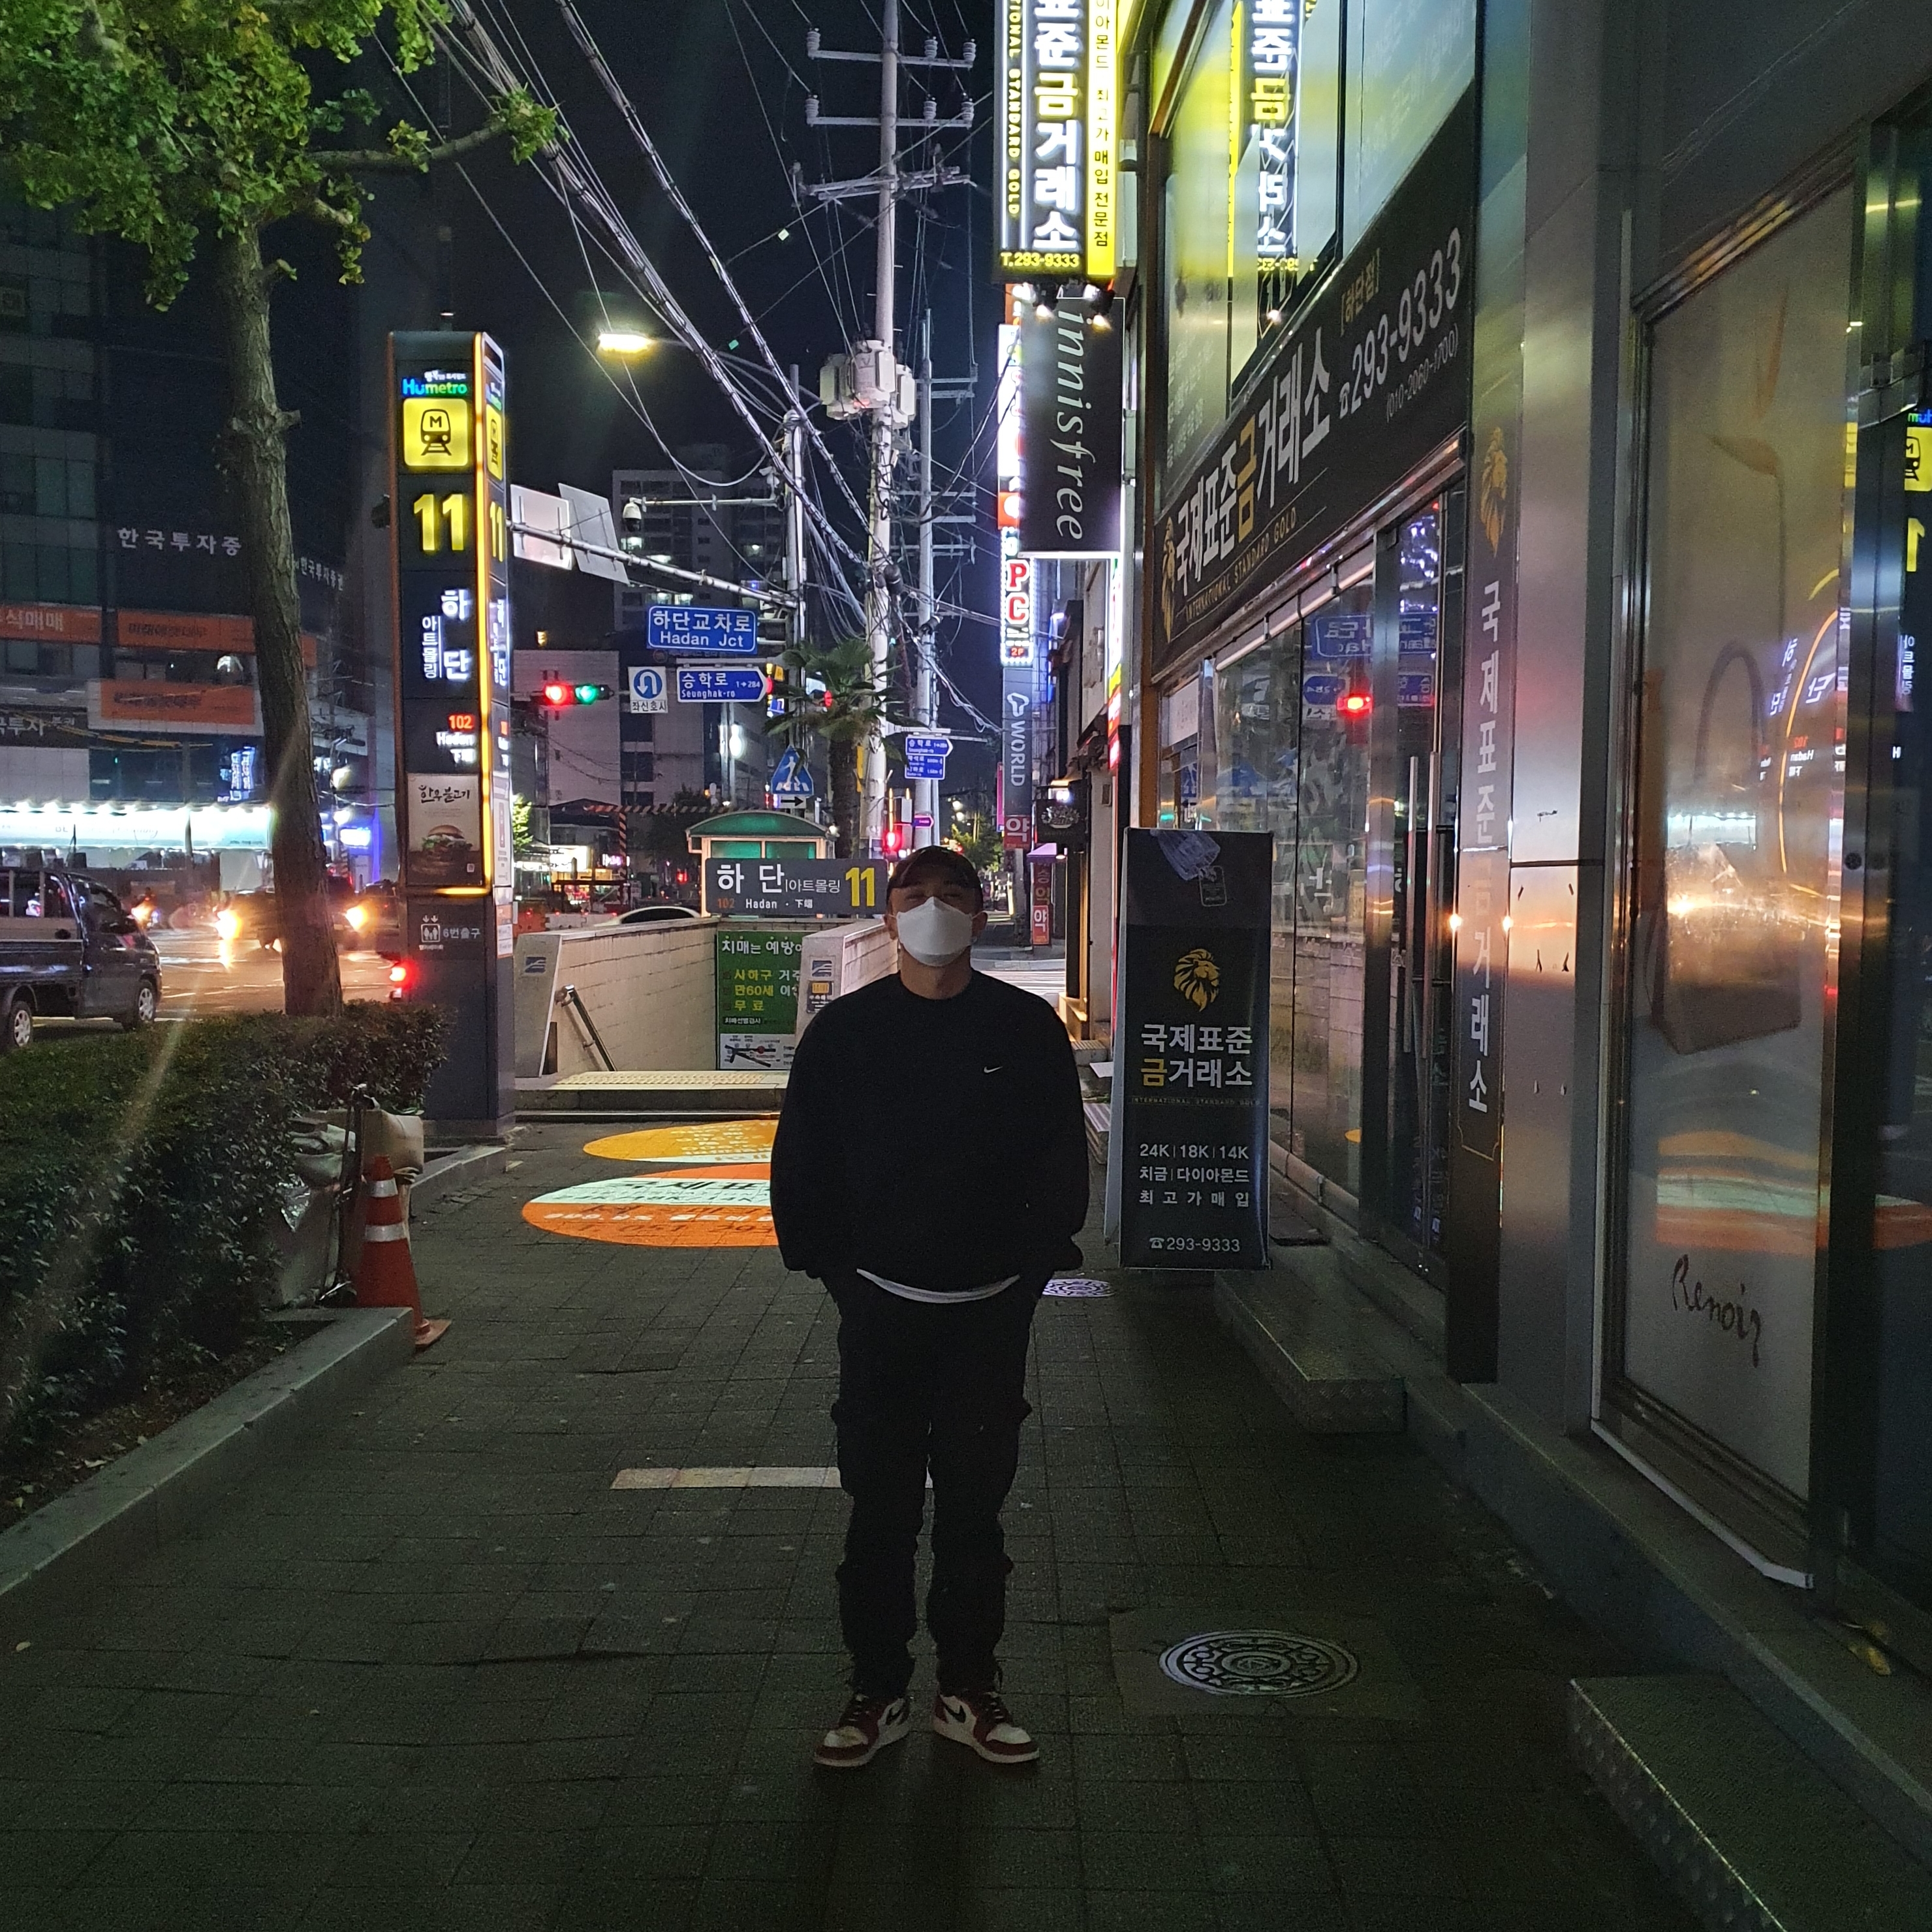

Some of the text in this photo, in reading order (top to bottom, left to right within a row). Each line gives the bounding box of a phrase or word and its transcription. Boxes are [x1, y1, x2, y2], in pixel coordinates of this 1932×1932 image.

[1008, 69, 1021, 157] STANDARD
[1008, 168, 1020, 214] GOLD
[1001, 252, 1080, 268] T.293-9333
[1350, 227, 1461, 414] 293-9333
[402, 379, 468, 395] Humetro
[1050, 309, 1097, 540] innisfree
[414, 493, 465, 552] 11
[490, 501, 504, 563] 11
[1274, 506, 1297, 544] GOLD
[653, 610, 752, 632] 하단교차로
[422, 615, 438, 679] 아트몰링
[661, 631, 744, 647] Hadan Jct
[681, 672, 728, 689] 승학로
[681, 689, 736, 700] Seunghak-ro
[632, 700, 666, 712] 좌신호시
[449, 715, 473, 729] 102
[436, 732, 475, 747] Hadan
[1010, 721, 1025, 787] WORLD
[1006, 818, 1030, 843] 약
[789, 879, 840, 894] 아트몰링
[845, 867, 875, 907] 11
[717, 898, 735, 909] 102
[745, 899, 777, 909] Hadan
[1034, 910, 1048, 933] 약
[722, 940, 761, 954] 치매는
[734, 969, 772, 981] 사하구
[734, 985, 773, 997] 만60세
[1141, 1023, 1253, 1054] 국제표준
[1141, 1059, 1253, 1088] 금거래소
[1140, 1144, 1249, 1159] 24K 18K 14K
[1139, 1167, 1249, 1183] 치금 다이아몬드
[1166, 1238, 1240, 1253] 293-9333
